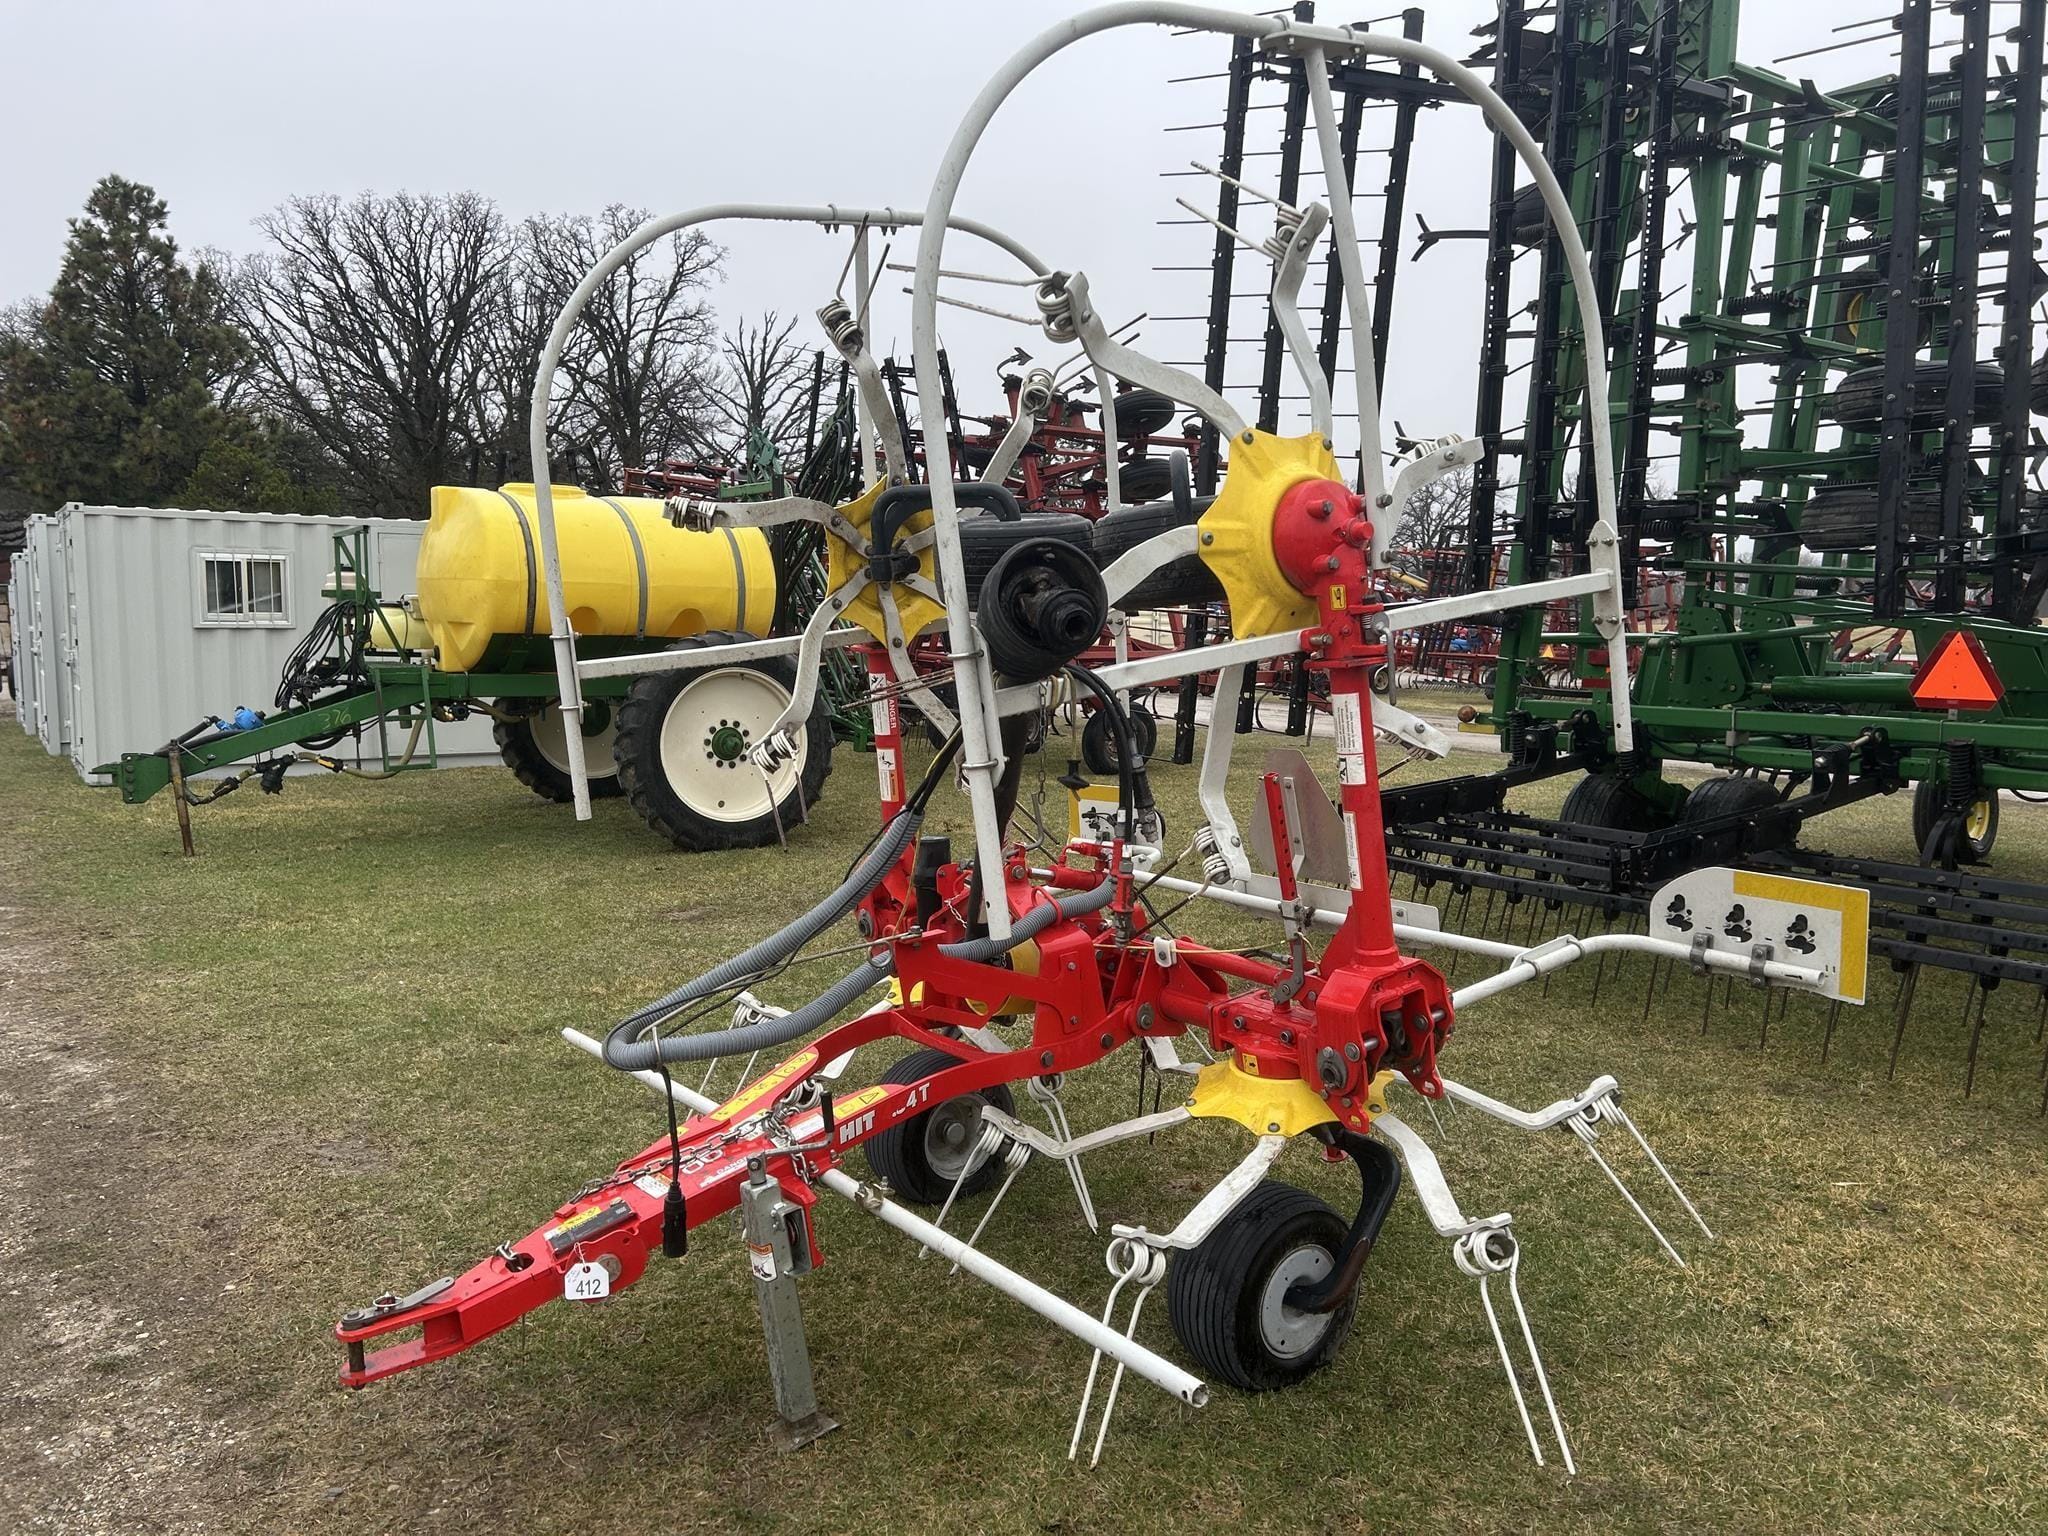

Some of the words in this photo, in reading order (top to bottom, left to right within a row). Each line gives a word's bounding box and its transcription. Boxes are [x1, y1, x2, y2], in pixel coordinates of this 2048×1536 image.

[318, 707, 352, 730] 376
[840, 1110, 876, 1145] HIT
[575, 1279, 602, 1296] 412
